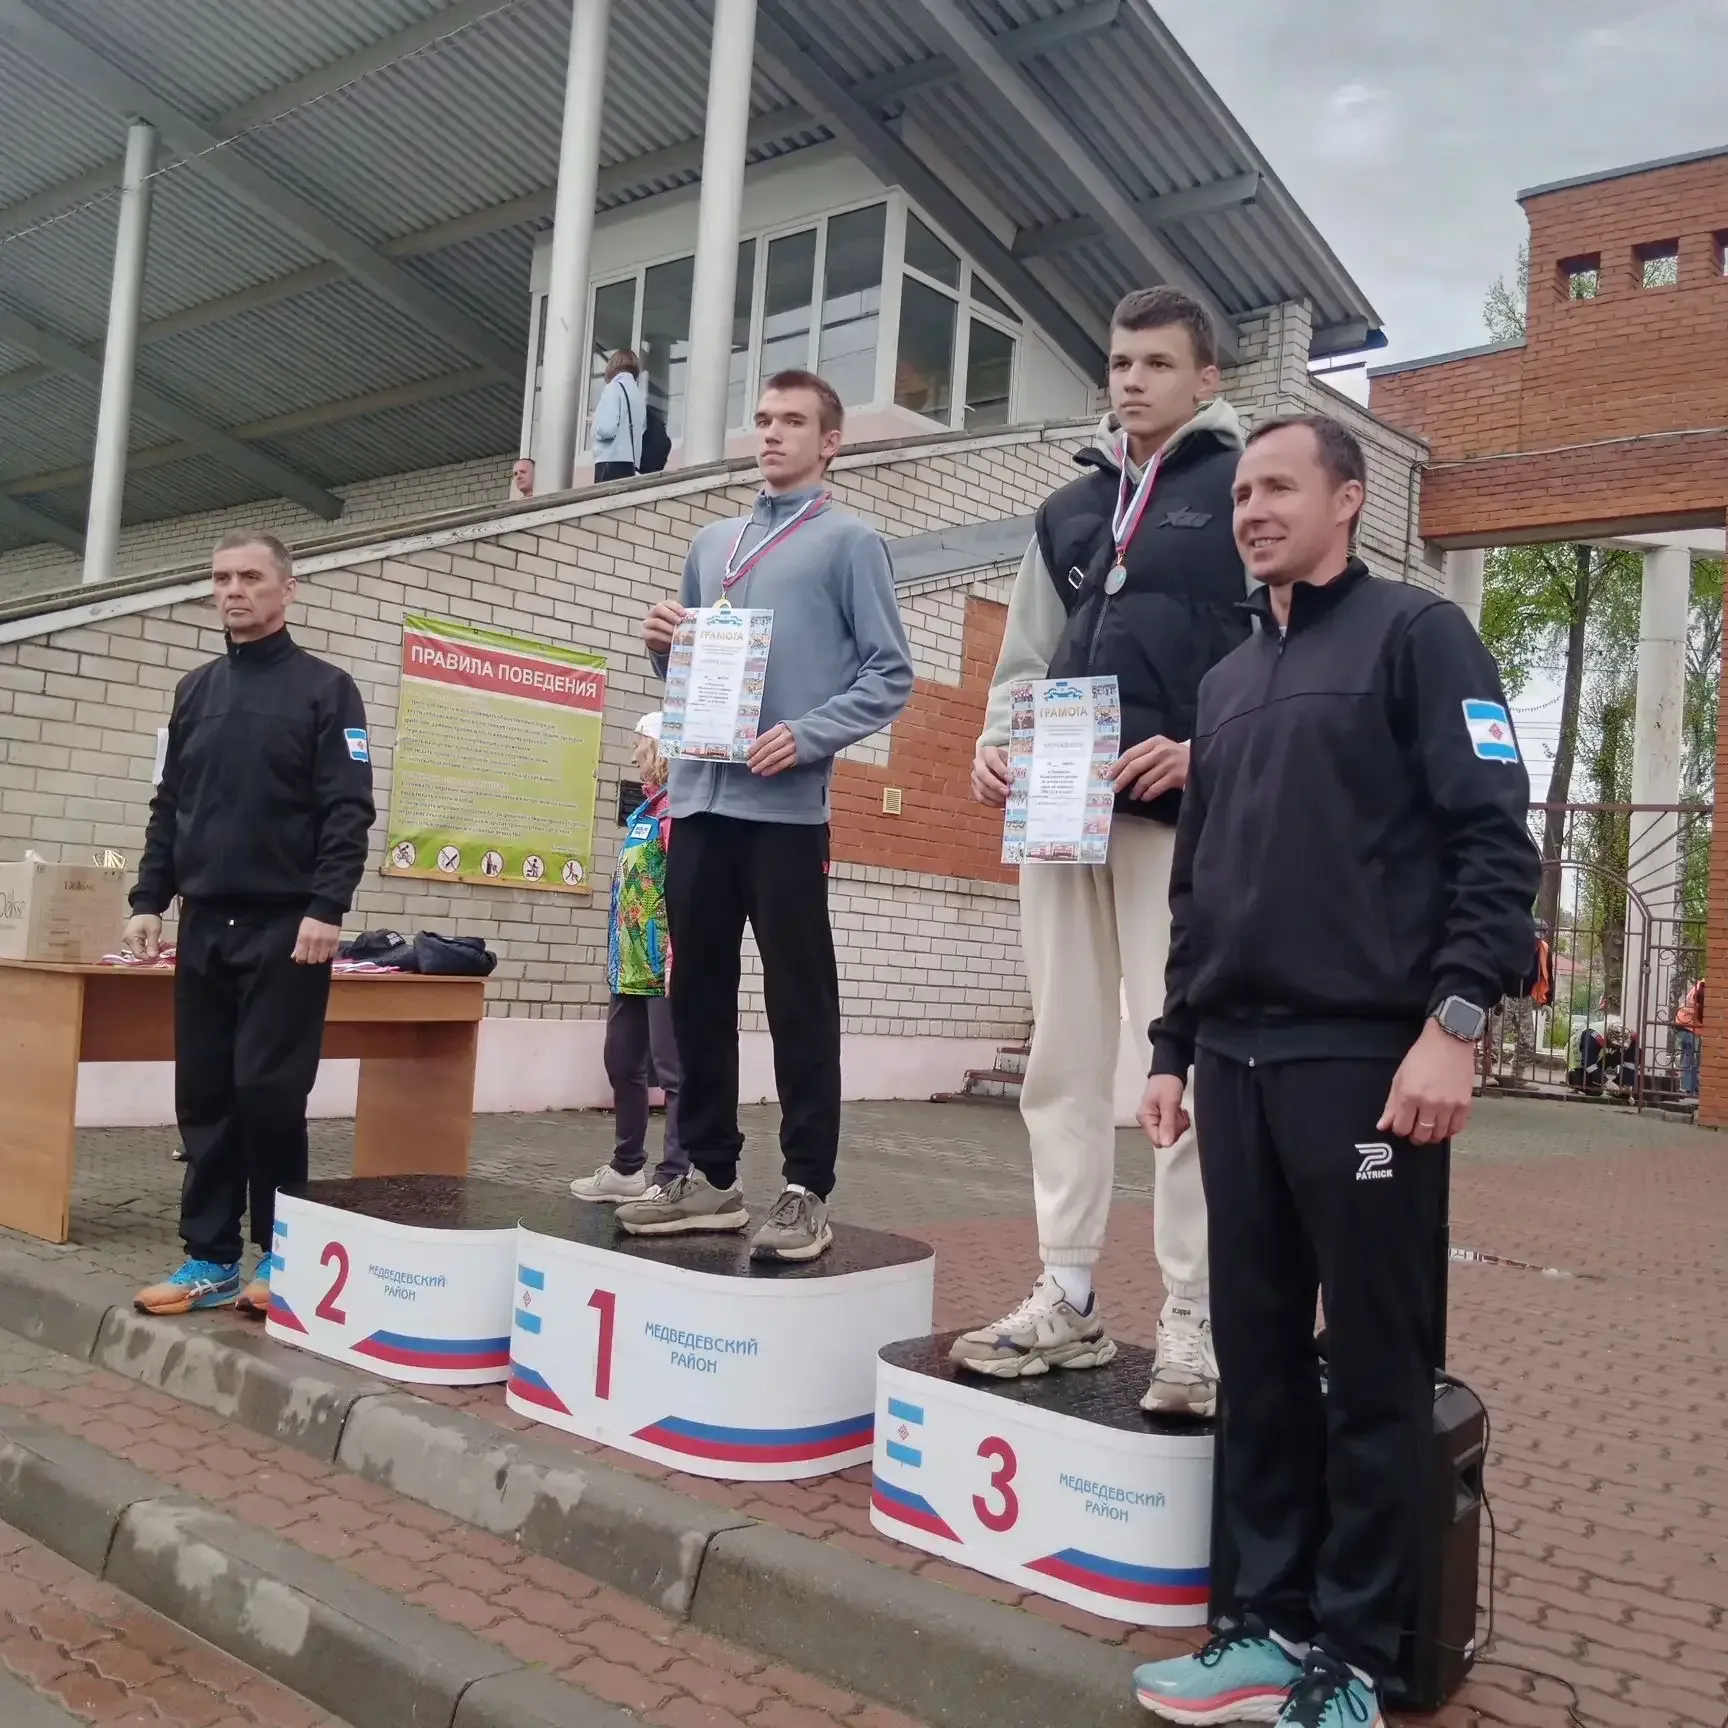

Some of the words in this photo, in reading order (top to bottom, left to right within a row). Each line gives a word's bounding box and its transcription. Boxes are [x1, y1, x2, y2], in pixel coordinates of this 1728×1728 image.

[700, 630, 743, 640] ГРАМОТА
[411, 645, 494, 678] ПРАВИЛА
[498, 663, 597, 698] ПОВЕДЕНИЯ
[1039, 706, 1088, 718] ГРАМОТА
[1356, 1169, 1393, 1180] PATRICK
[315, 1241, 350, 1325] 2
[368, 1263, 446, 1288] МЕДВЕДЕВСКИЙ
[384, 1285, 416, 1300] РАЙОН
[587, 1288, 616, 1400] 1
[645, 1321, 759, 1355] МЕДВЕДЕВСКИЙ
[671, 1351, 718, 1374] РАЙОН
[972, 1436, 1019, 1532] 3
[1059, 1472, 1166, 1508] МЕДВЕДЕВСКИЙ
[1085, 1499, 1129, 1522] РАЙОН
